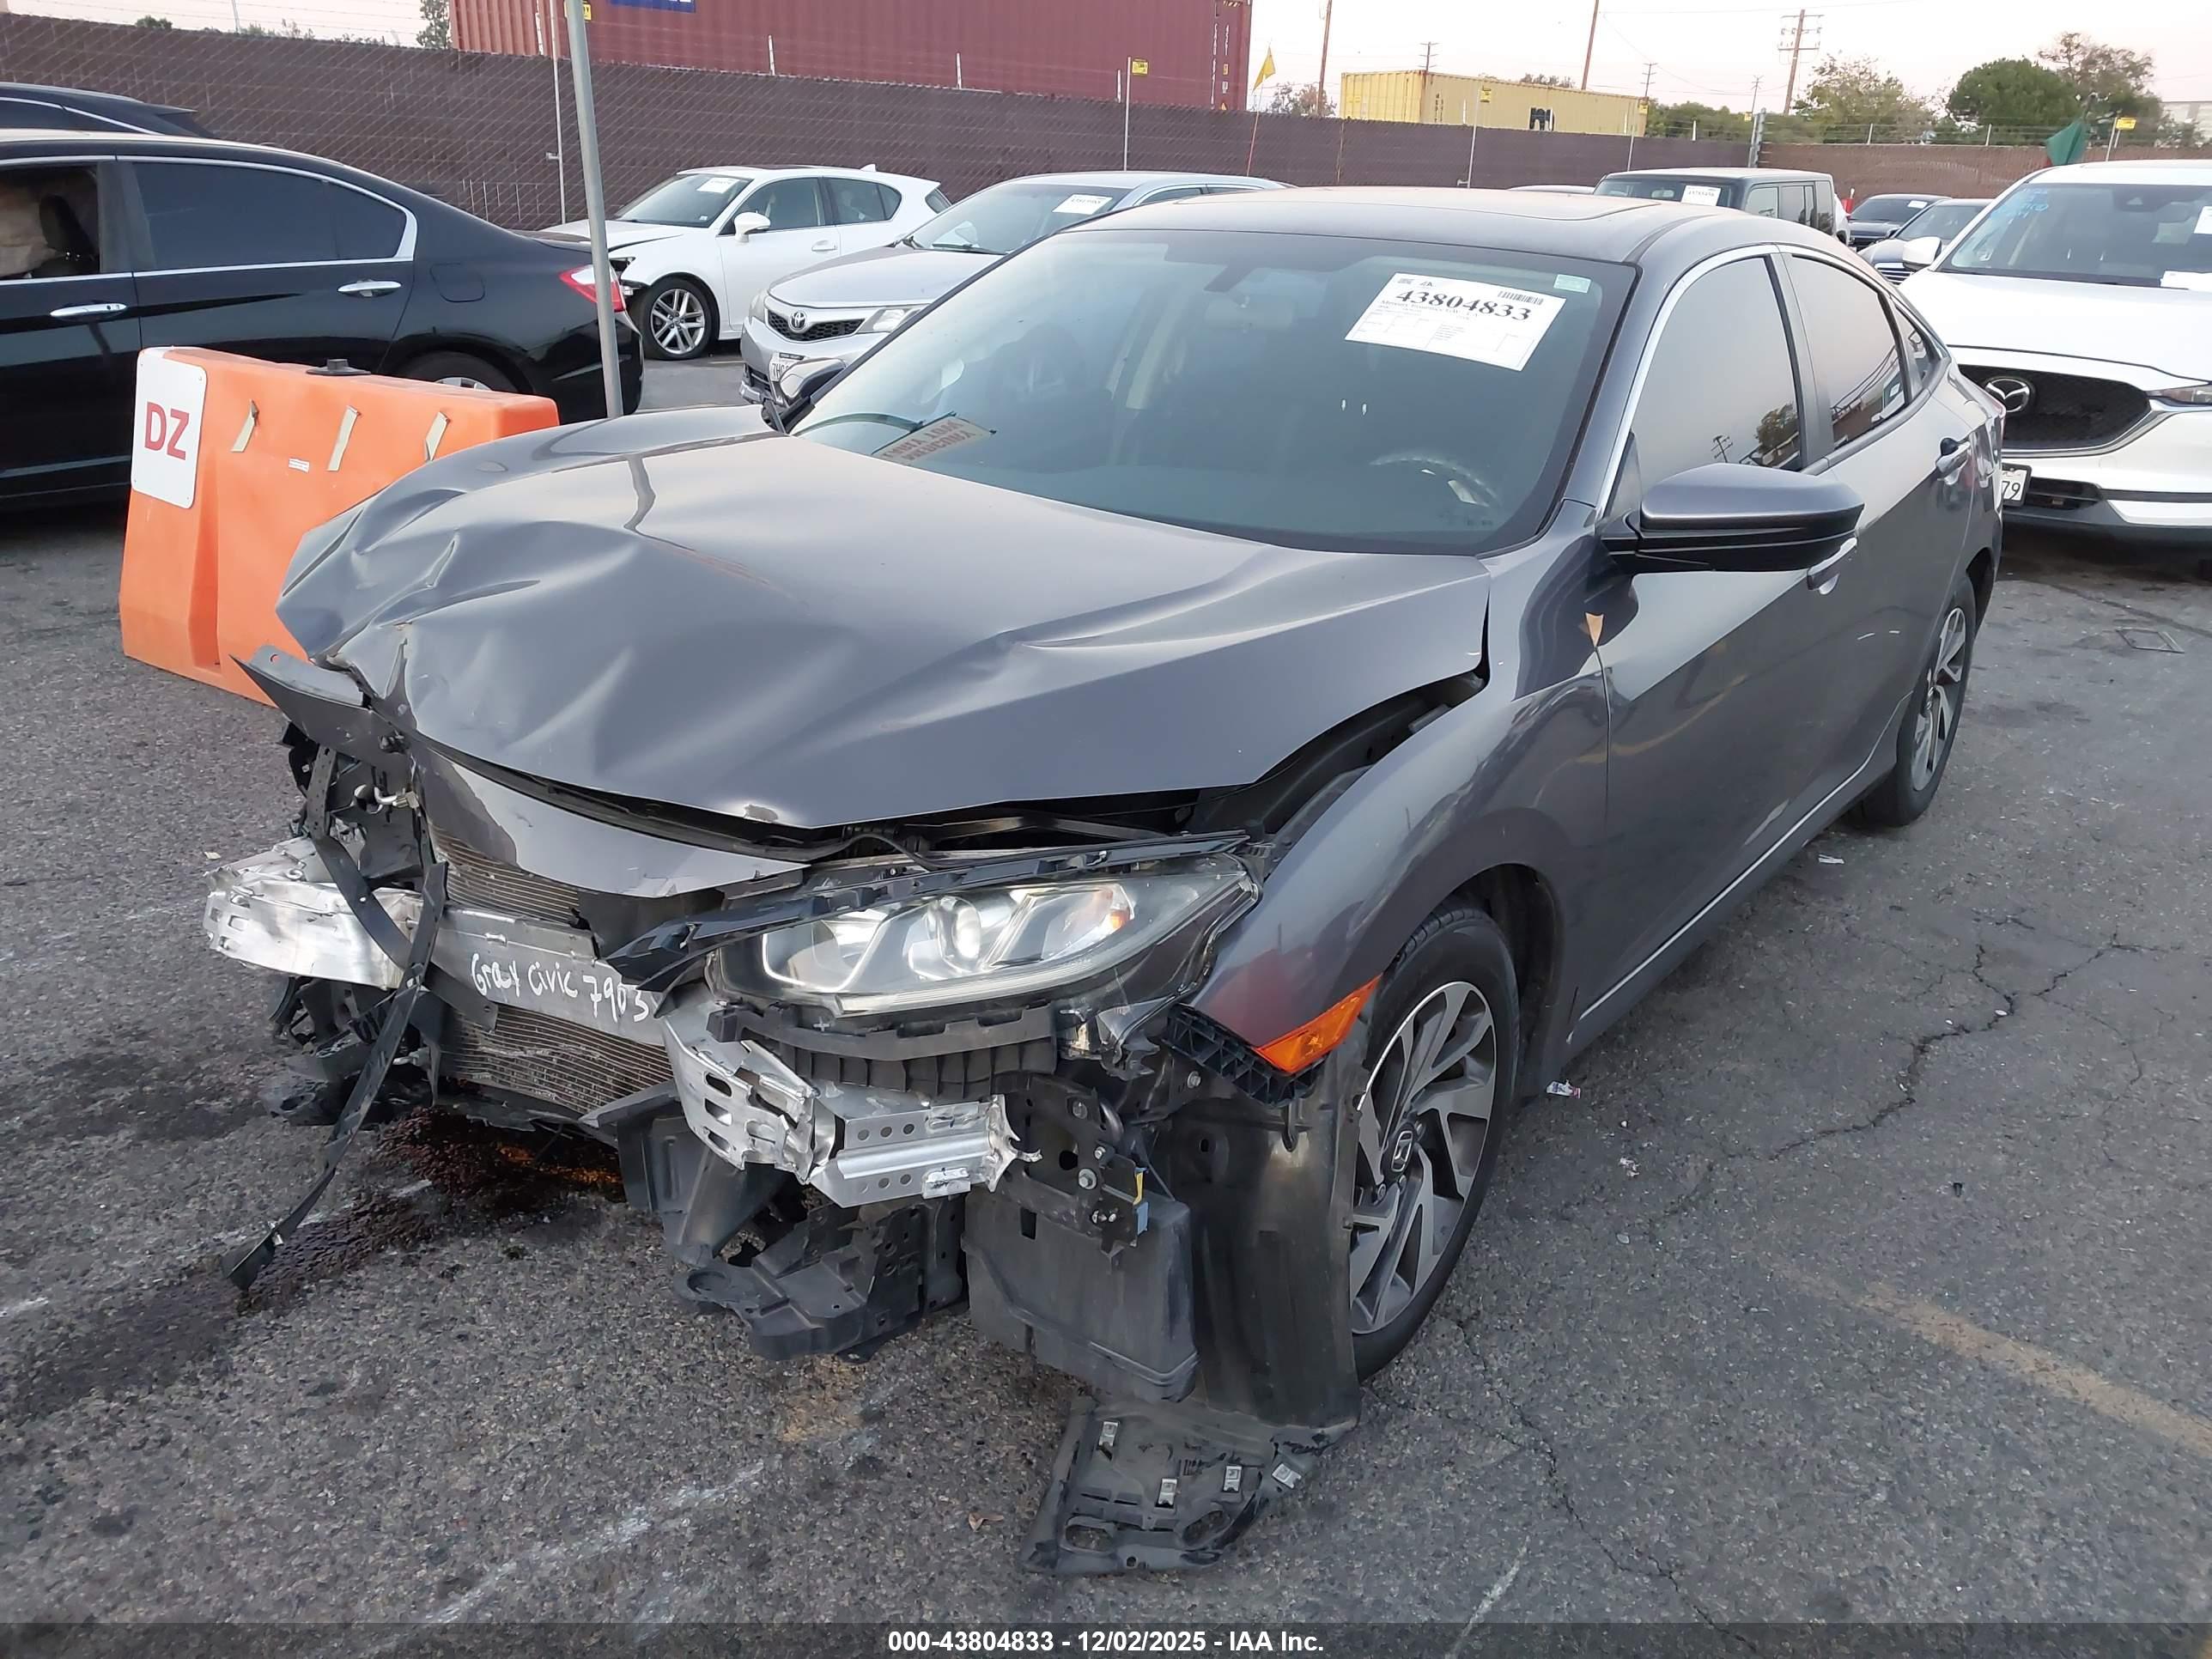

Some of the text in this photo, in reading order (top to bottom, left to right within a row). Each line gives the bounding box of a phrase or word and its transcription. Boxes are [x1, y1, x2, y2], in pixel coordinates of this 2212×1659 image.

[1395, 289, 1532, 321] 43804833
[144, 401, 190, 460] DZ
[527, 961, 579, 998] Civic
